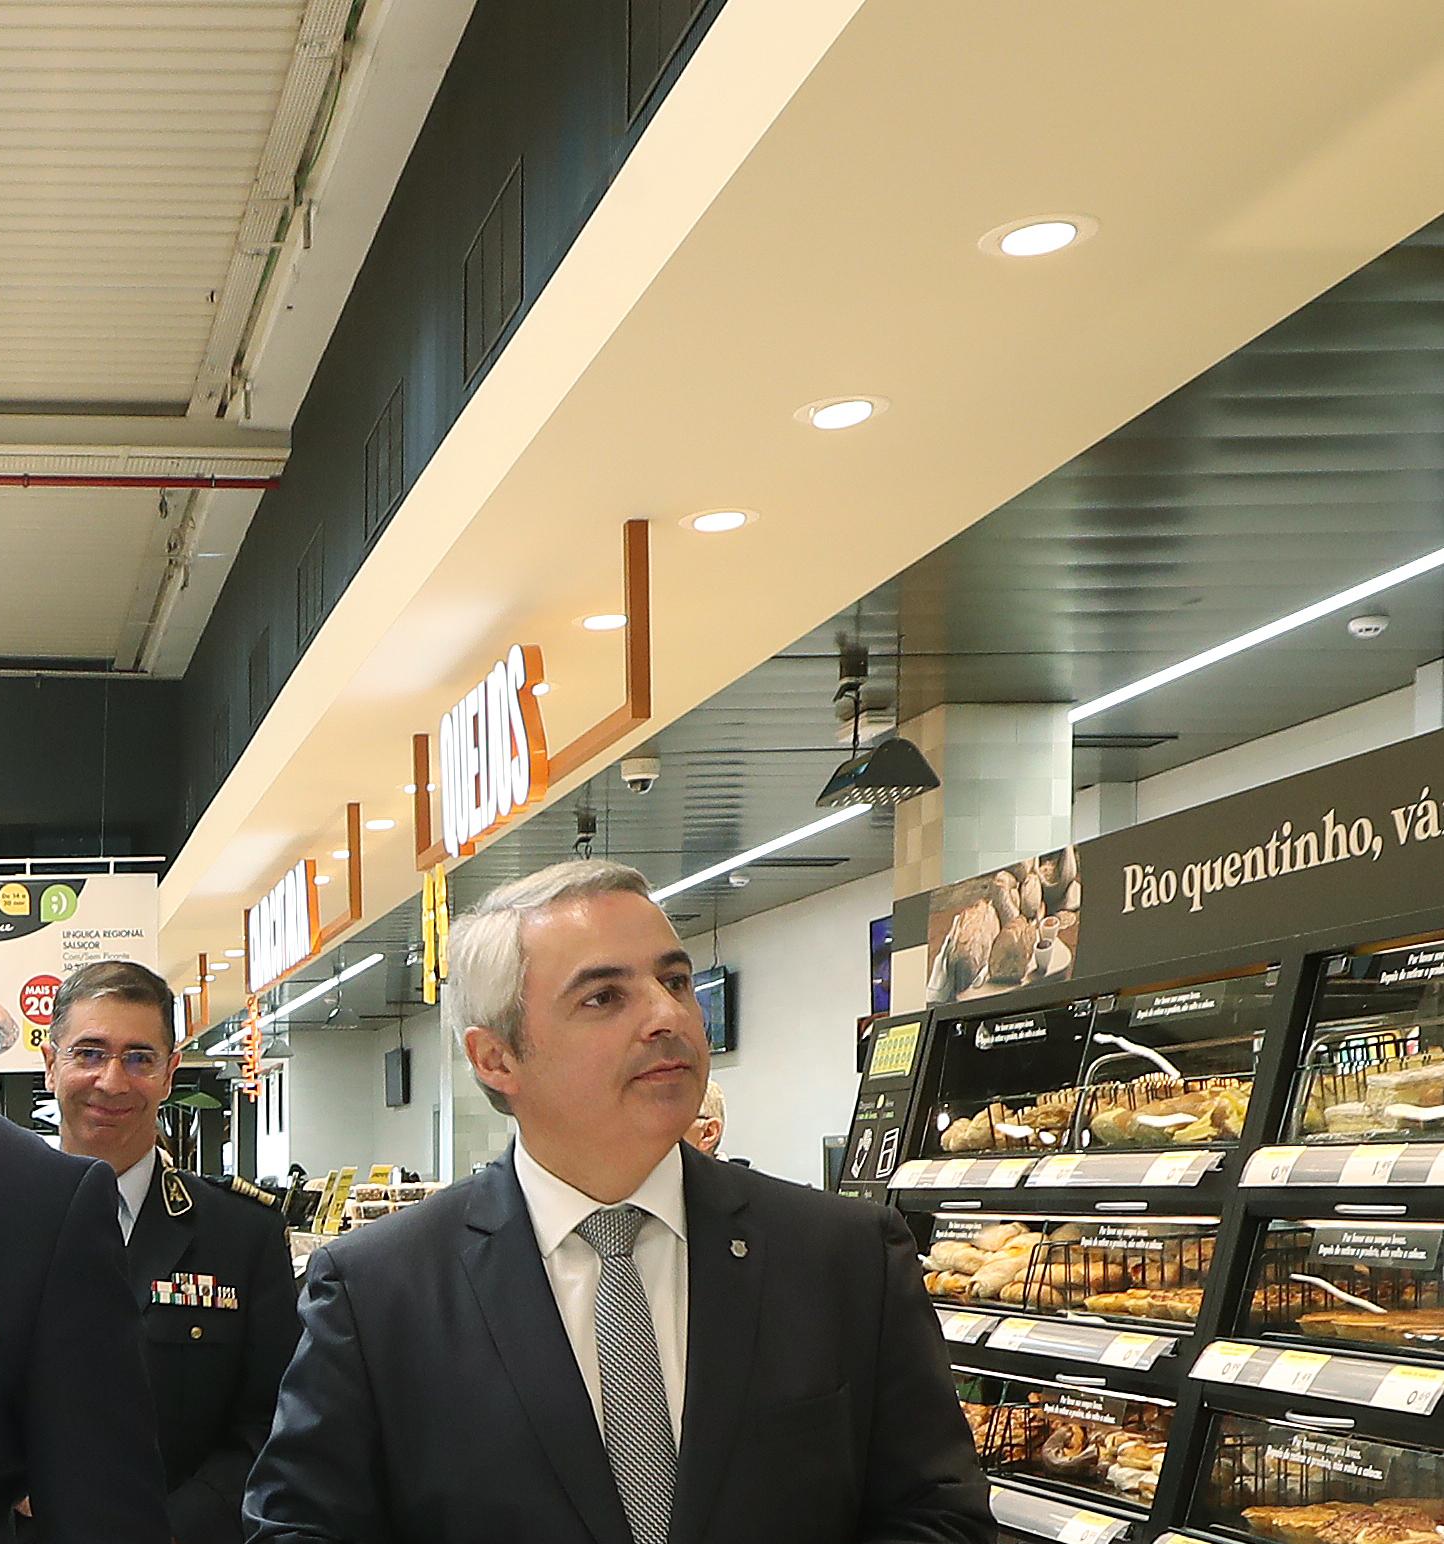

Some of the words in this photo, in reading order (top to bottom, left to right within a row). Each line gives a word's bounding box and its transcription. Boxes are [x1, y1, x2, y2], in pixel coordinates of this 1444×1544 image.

[1121, 863, 1178, 914] Pão
[1181, 809, 1383, 913] quentinho,
[1391, 785, 1444, 846] vá
[103, 929, 144, 938] REGIONAL
[25, 985, 50, 995] MAIS
[25, 996, 55, 1016] 20
